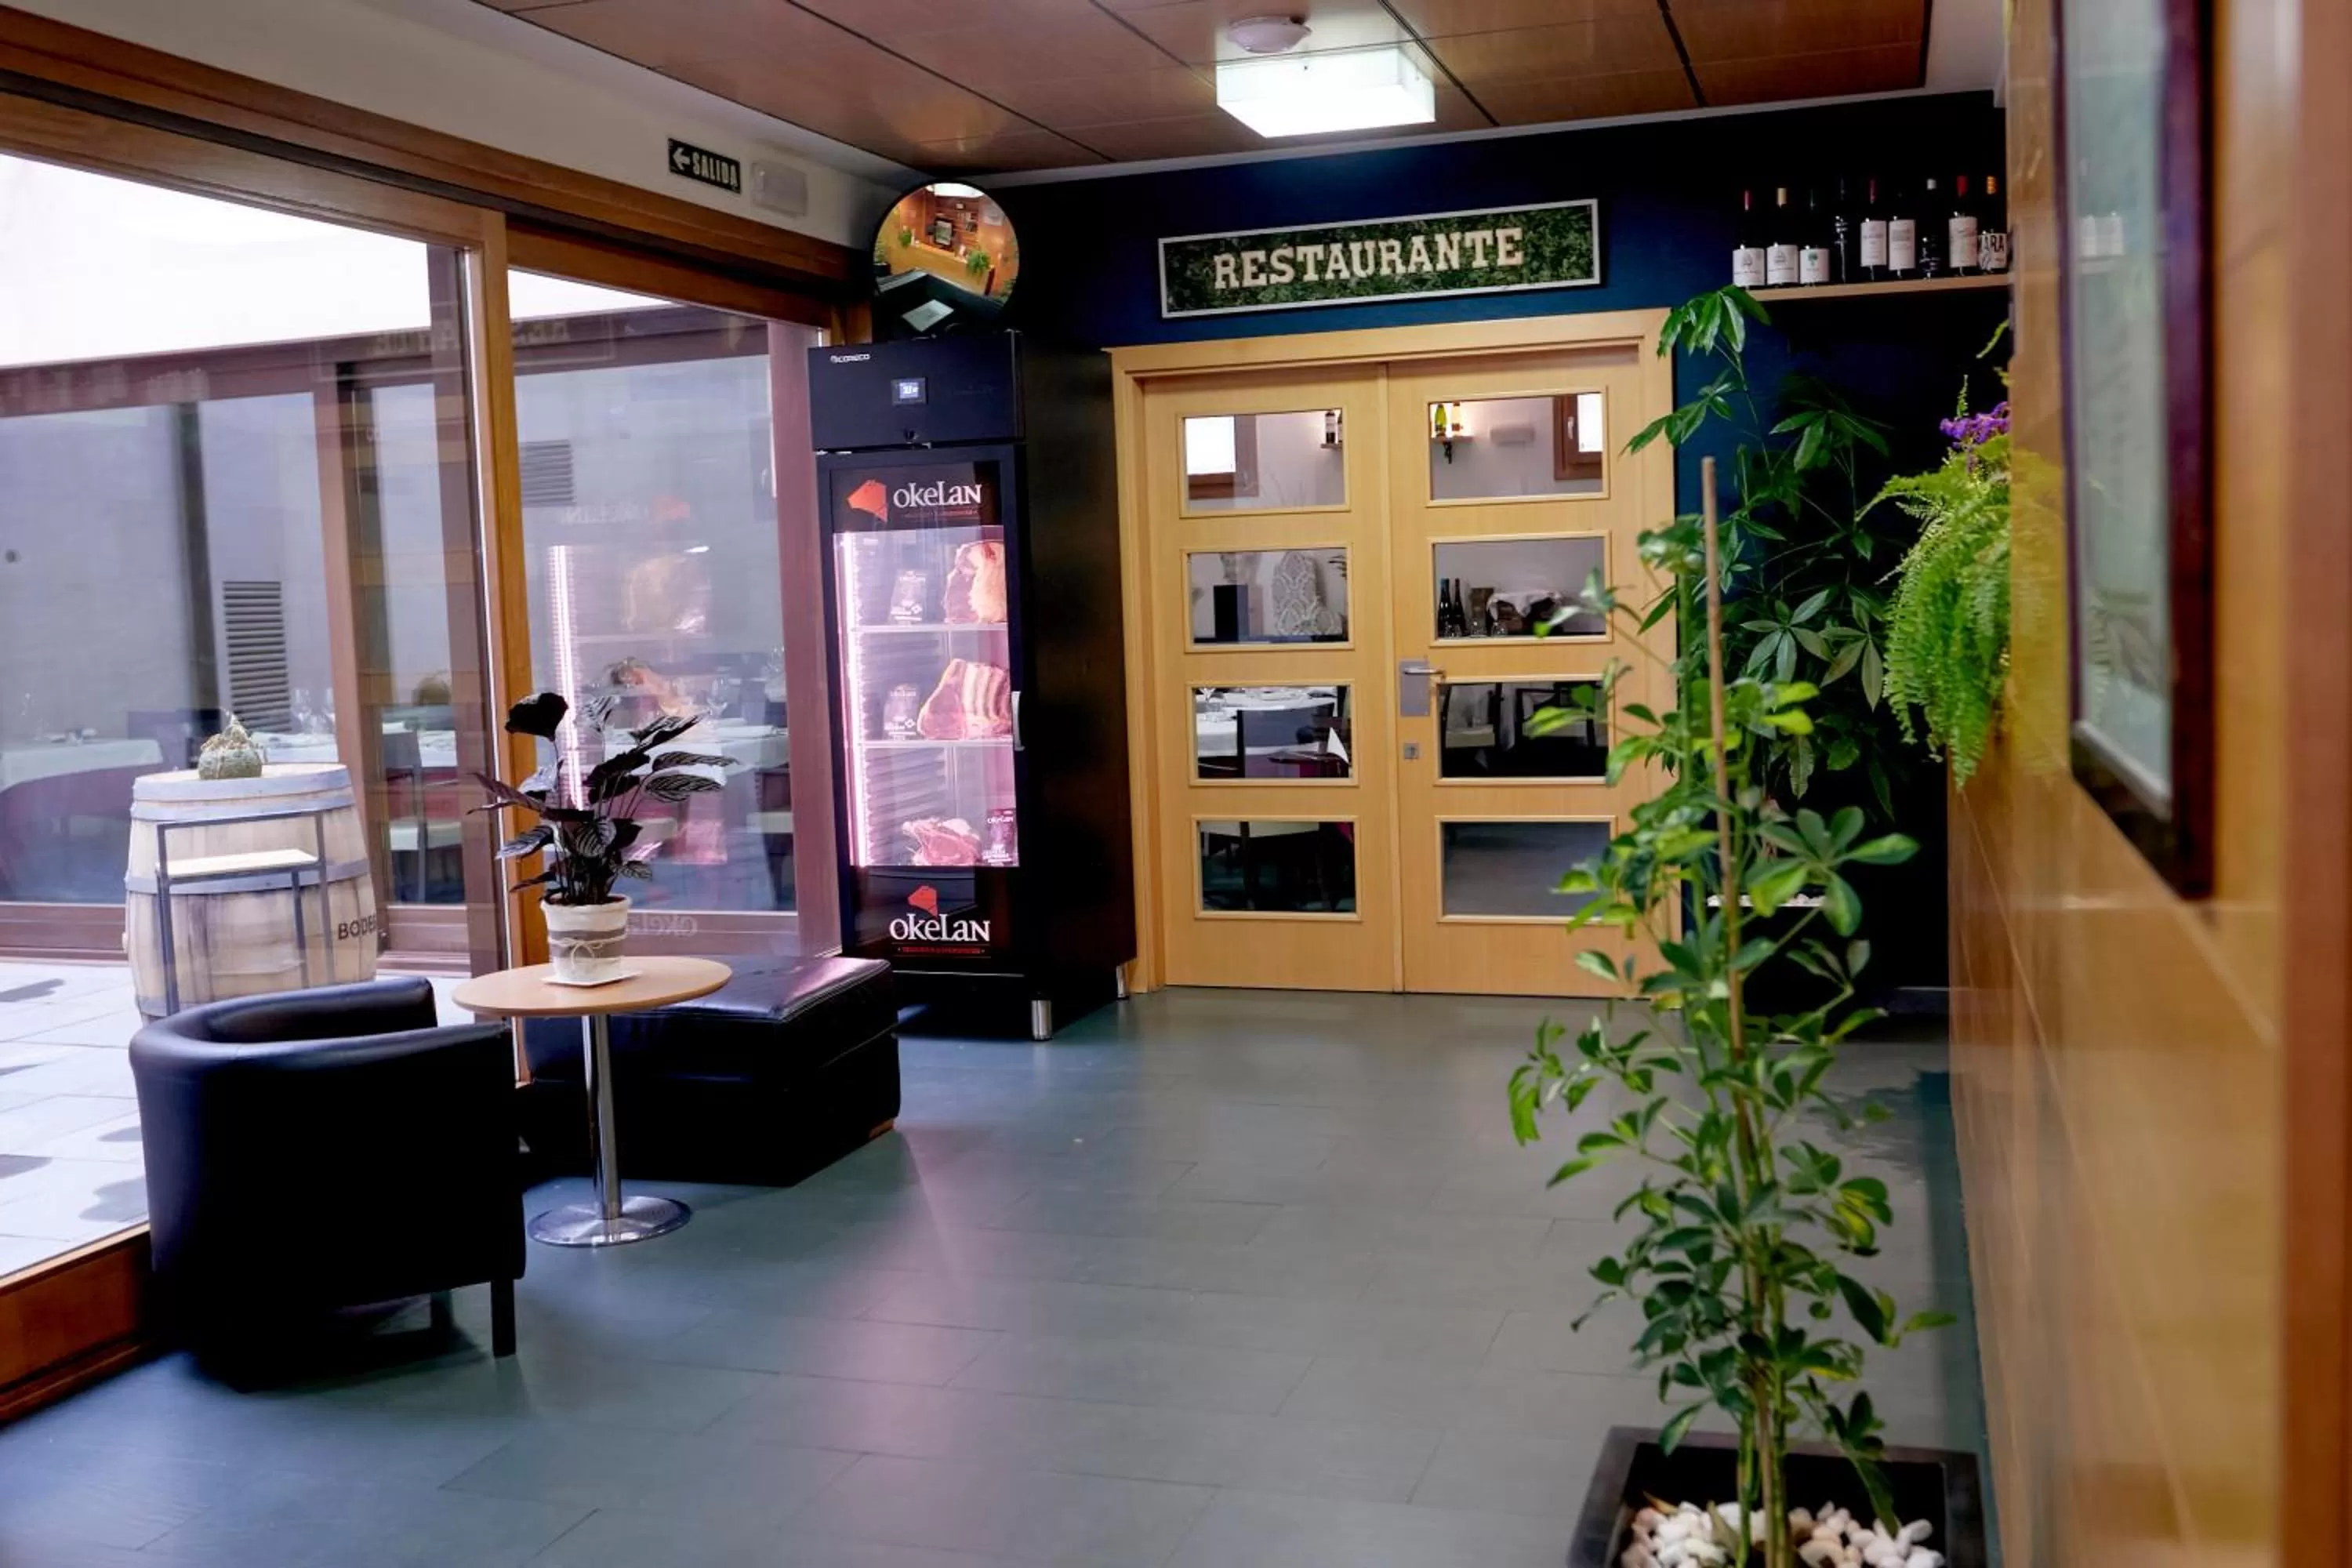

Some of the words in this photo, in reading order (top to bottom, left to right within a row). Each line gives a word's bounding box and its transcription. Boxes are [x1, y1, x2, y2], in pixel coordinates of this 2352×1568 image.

[692, 152, 739, 187] SALIDA
[1213, 228, 1524, 289] RESTAURANTE
[339, 915, 377, 940] BODE
